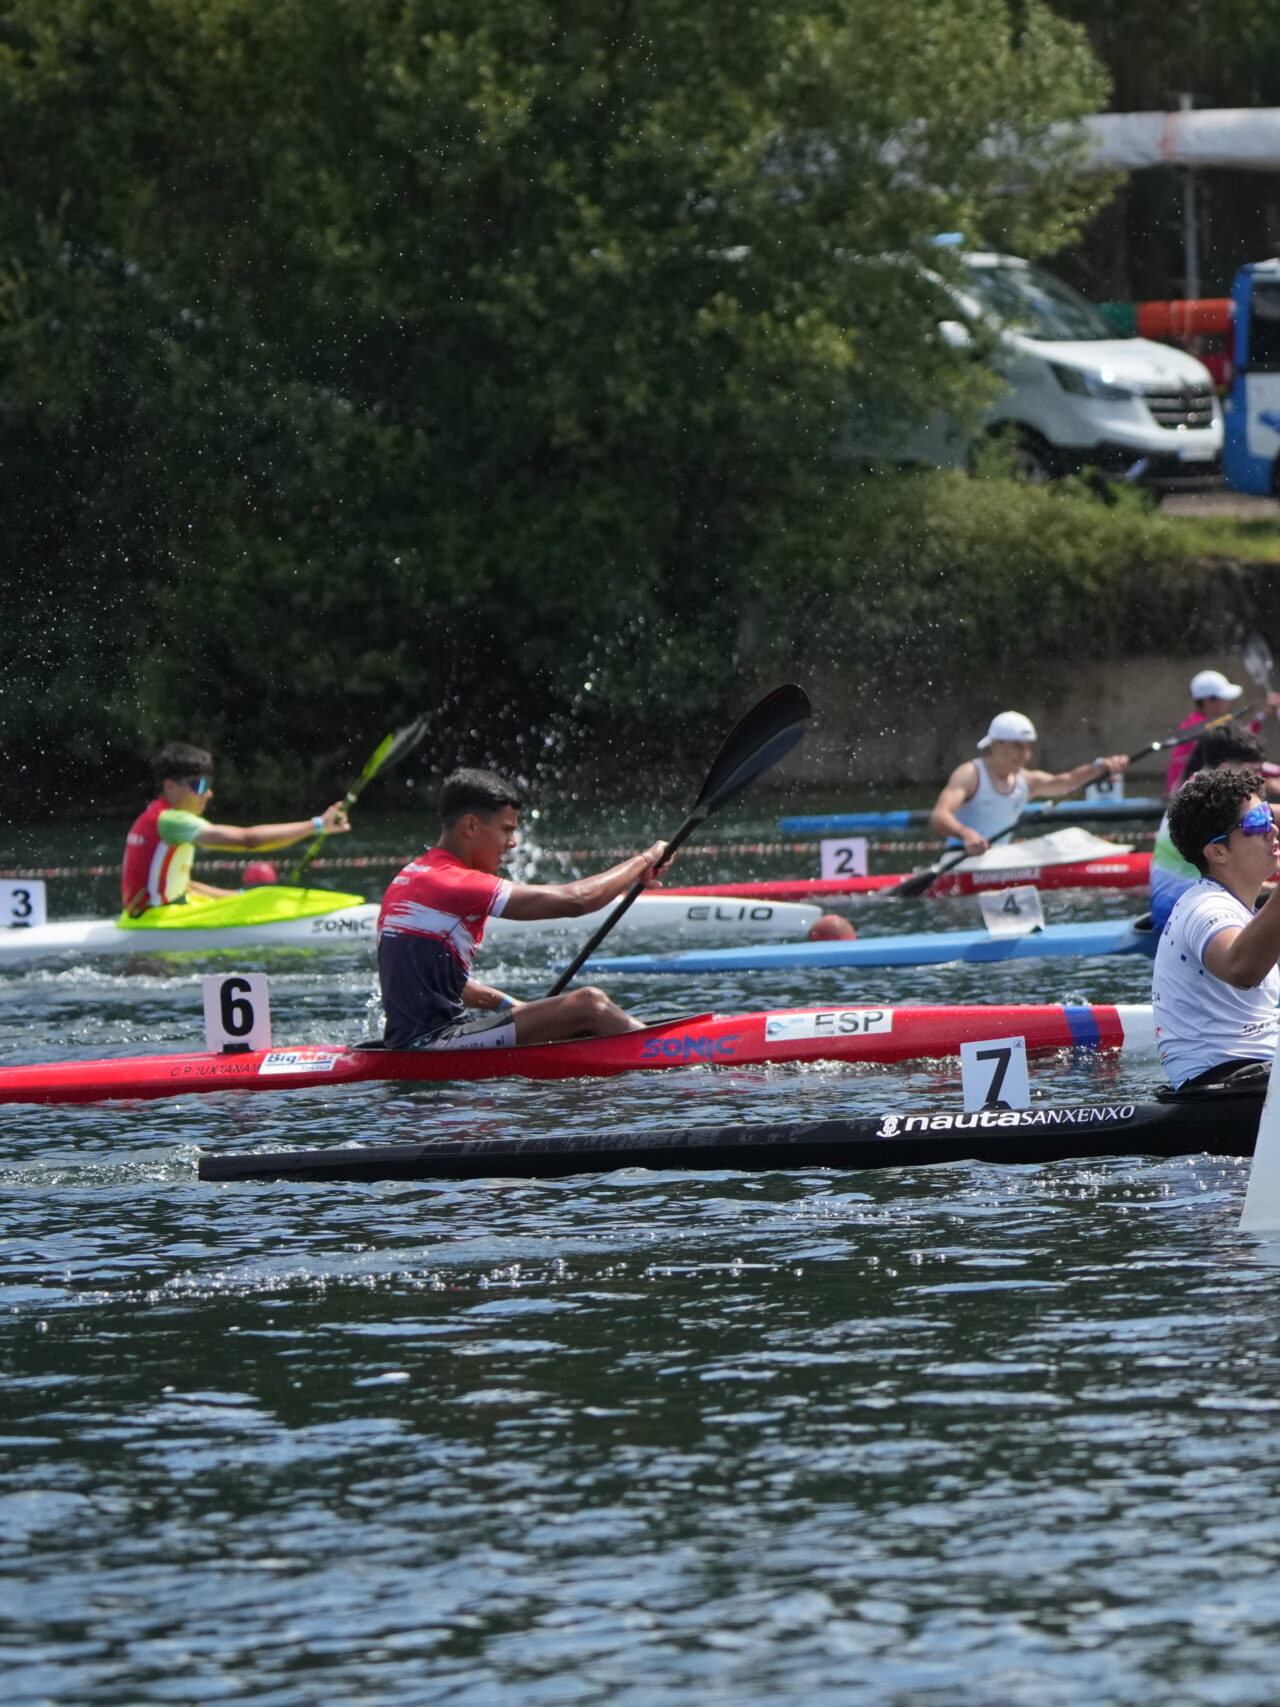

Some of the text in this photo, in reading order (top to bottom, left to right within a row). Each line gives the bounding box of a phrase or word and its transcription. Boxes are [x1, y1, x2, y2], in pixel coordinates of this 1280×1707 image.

[833, 847, 854, 875] 2
[11, 888, 33, 918] 3
[687, 906, 773, 921] ELIO
[1001, 893, 1021, 915] 4
[312, 917, 375, 934] SONIC
[220, 977, 255, 1037] 6
[815, 1011, 884, 1035] ESP
[640, 1034, 742, 1063] SONIC
[976, 1047, 1012, 1104] 7
